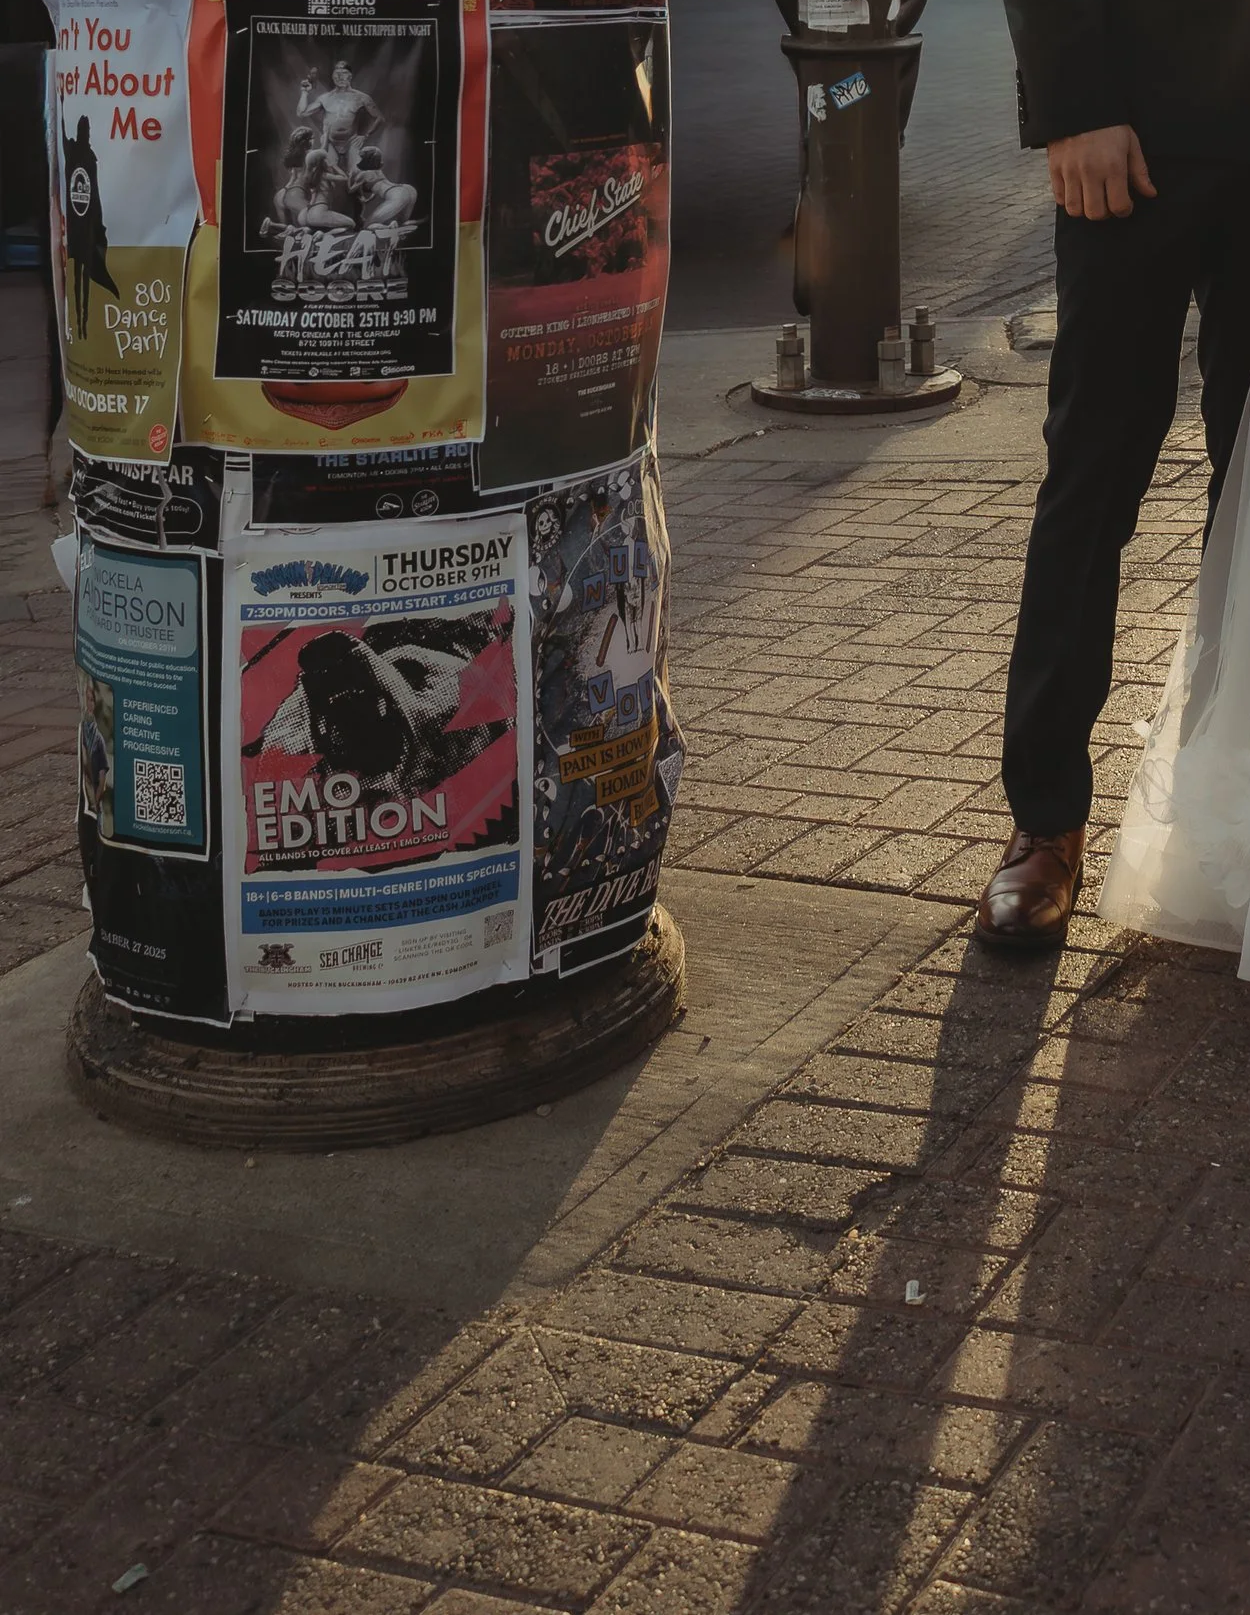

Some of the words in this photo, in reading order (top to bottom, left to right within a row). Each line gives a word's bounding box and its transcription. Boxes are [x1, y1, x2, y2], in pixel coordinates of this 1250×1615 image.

[330, 5, 376, 16] cinema
[84, 17, 131, 52] You
[256, 21, 281, 35] CRACK
[281, 22, 307, 36] DEALER
[308, 23, 319, 36] BY
[342, 24, 363, 37] MALE
[363, 24, 396, 37] STRIPPER
[397, 24, 408, 37] BY
[408, 24, 431, 37] NIGHT
[84, 59, 176, 98] About
[109, 106, 163, 142] Me
[545, 189, 599, 247] Chief
[602, 171, 644, 216] State
[274, 224, 419, 283] HEAT
[135, 278, 172, 307] 80s
[103, 303, 168, 331] Dance
[235, 308, 298, 328] SATURDAY
[300, 310, 355, 329] OCTOBER
[358, 310, 389, 328] 25TH
[392, 309, 416, 327] 9:30
[418, 307, 437, 324] PM
[273, 329, 300, 339] METRO
[301, 329, 332, 339] CINEMA
[363, 329, 401, 338] GARNEAU
[500, 323, 544, 340] GUTTER
[546, 319, 570, 334] KING
[114, 327, 169, 360] Party
[344, 339, 376, 348] STREET
[578, 353, 609, 370] DOORS
[133, 394, 151, 415] 17
[314, 453, 351, 468] THE
[355, 448, 440, 466] STARLITE
[381, 536, 514, 576] THURSDAY
[381, 573, 467, 594] OCTOBER
[471, 563, 501, 582] 9TH
[246, 606, 296, 619] 7:30PM
[351, 600, 402, 615] 8:30PM
[404, 596, 446, 609] START
[453, 591, 468, 604] $4
[468, 584, 509, 601] COVER
[289, 590, 323, 600] PRESENTS
[124, 623, 175, 642] TRUSTEE
[122, 698, 179, 716] EXPERIENCED
[122, 712, 153, 727] CARING
[122, 726, 161, 741] CREATIVE
[122, 740, 181, 757] PROGRESSIVE
[563, 752, 597, 777] PAIN
[253, 772, 361, 816] EMO
[256, 792, 448, 851] EDITION
[258, 852, 274, 862] ALL
[275, 850, 307, 862] BANDS
[321, 846, 351, 857] COVER
[365, 841, 392, 853] LEAST
[399, 836, 421, 847] EMO
[422, 831, 449, 843] SONG
[294, 888, 334, 901] BANDS
[339, 880, 423, 899] MULTI-GENRE
[429, 874, 465, 889] DRINK
[466, 861, 517, 882] SPECIALS
[353, 912, 394, 925] CHANCE
[132, 940, 142, 954] 27
[143, 944, 167, 961] 2025
[319, 950, 340, 968] SEA
[341, 939, 384, 965] CHANGE
